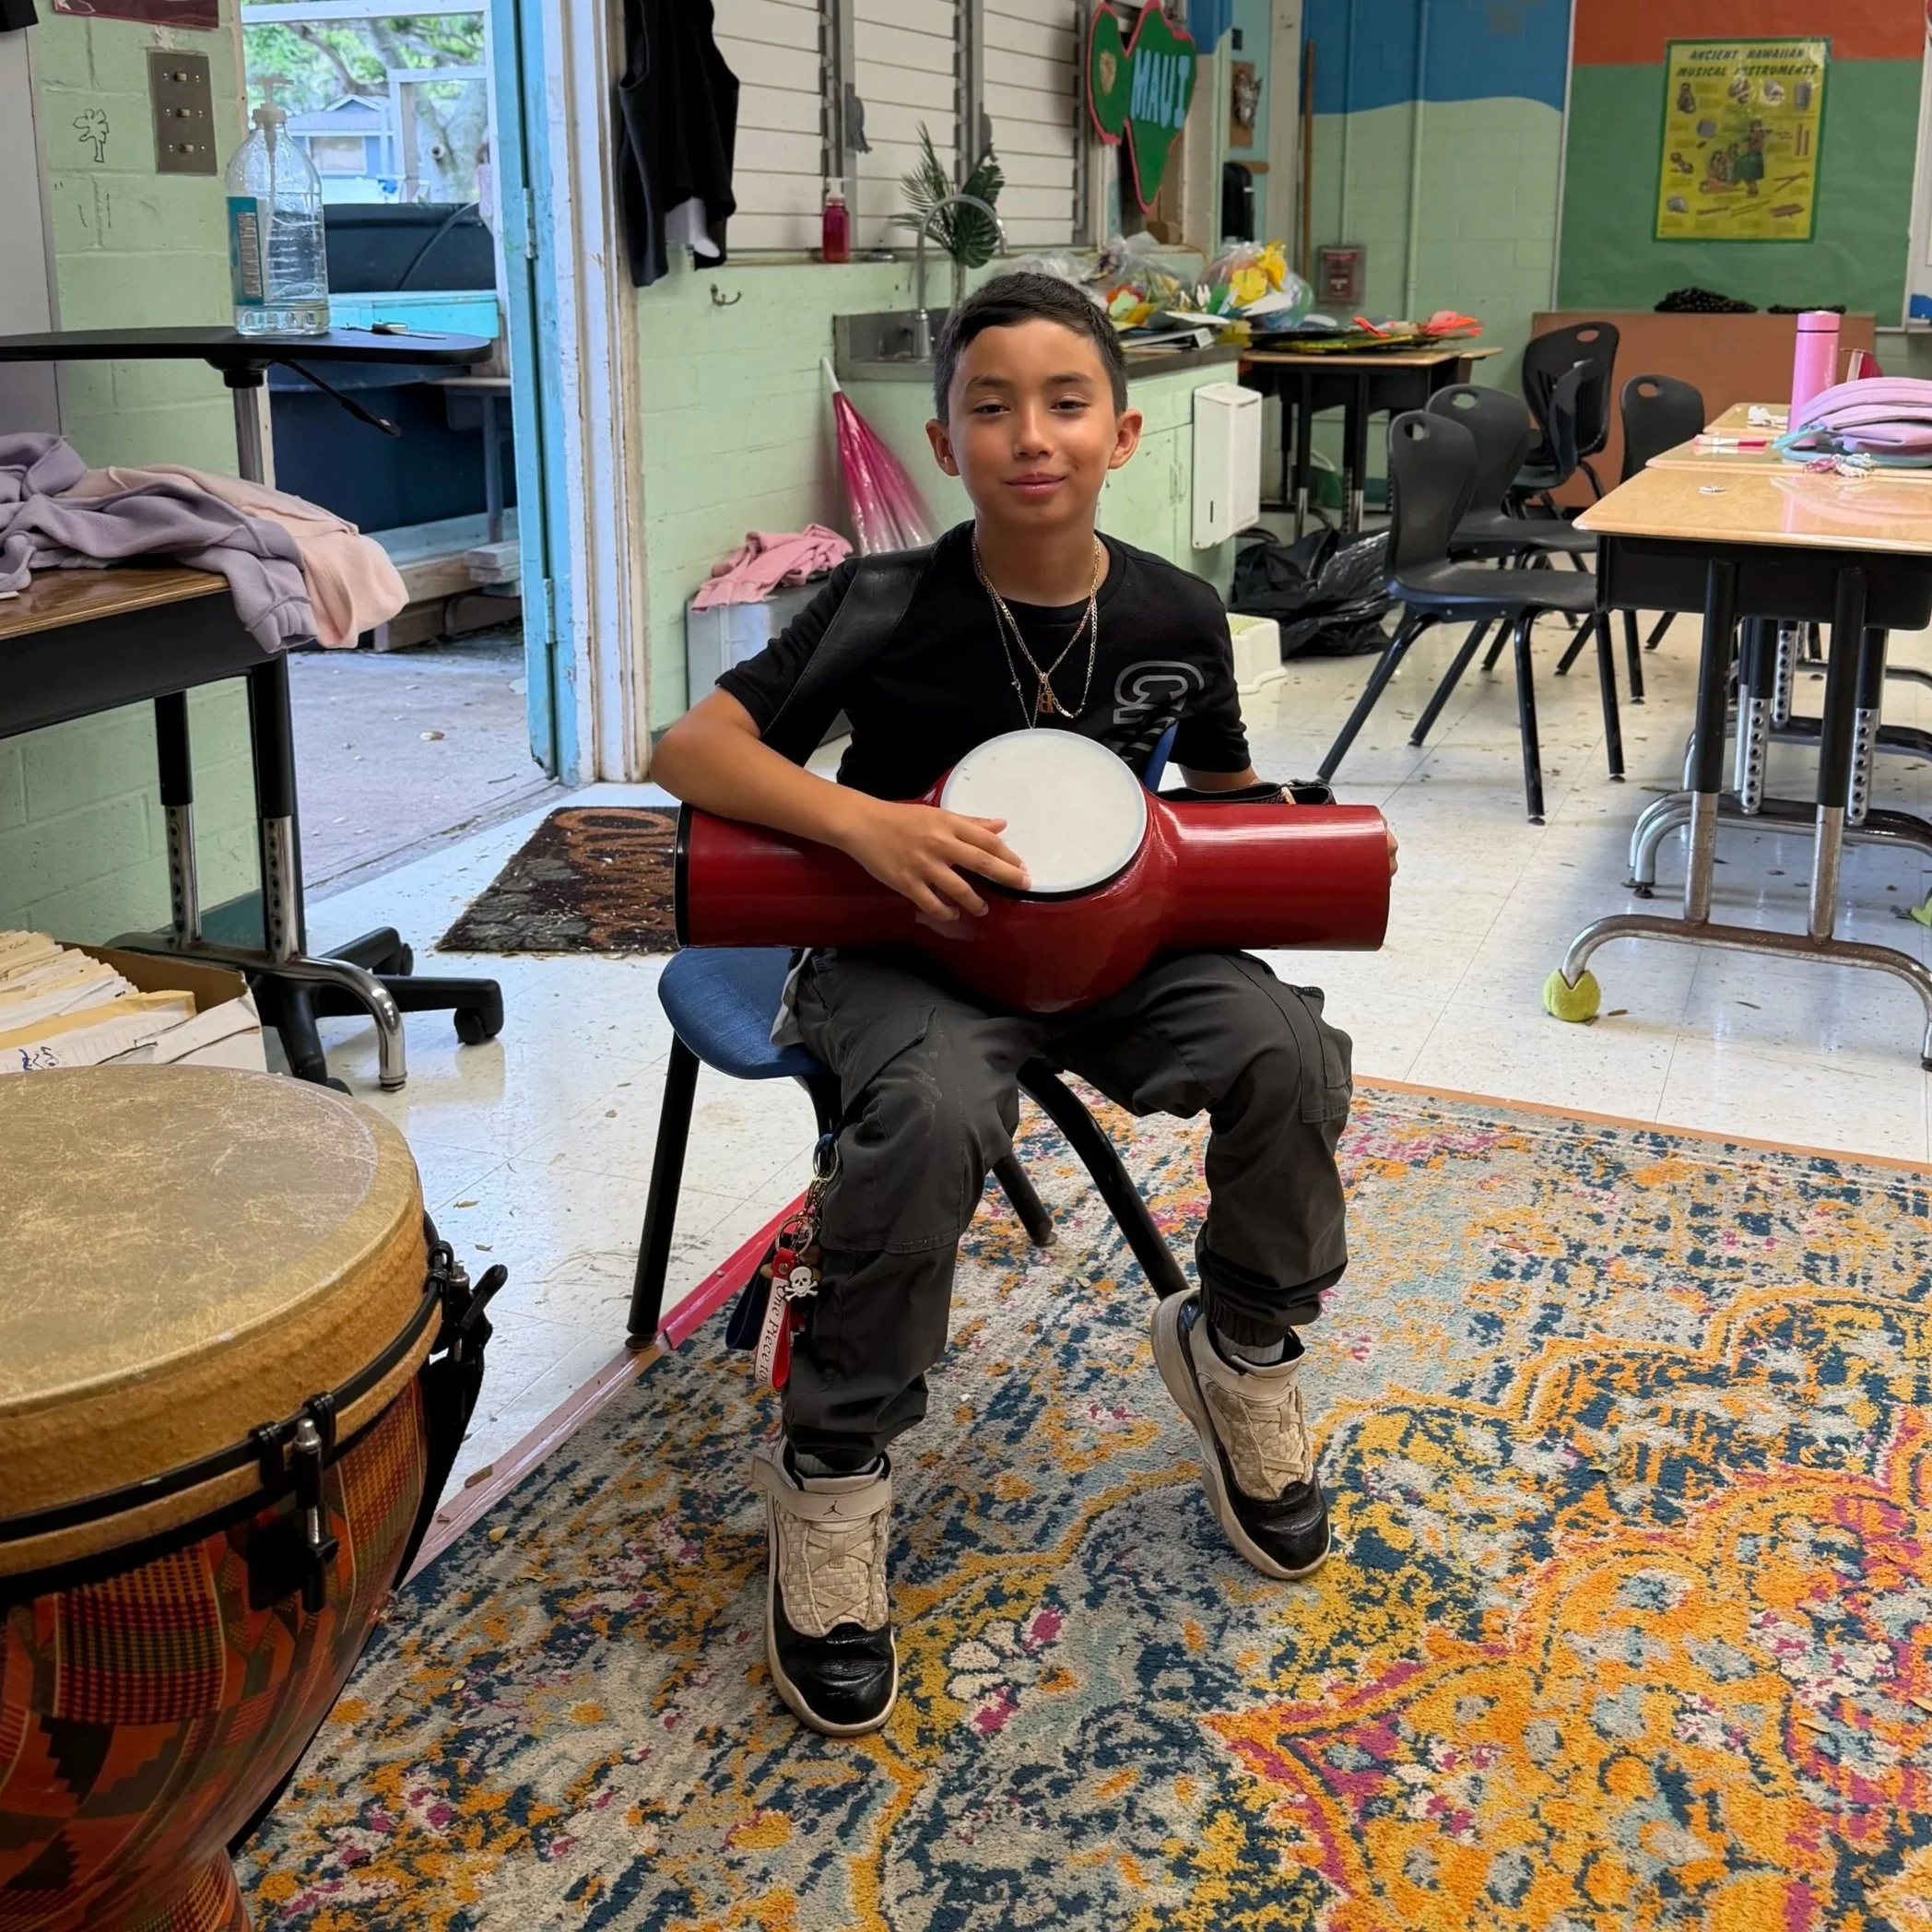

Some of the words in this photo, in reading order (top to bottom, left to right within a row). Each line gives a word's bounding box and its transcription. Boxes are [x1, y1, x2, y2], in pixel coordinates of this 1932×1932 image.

[1689, 49, 1738, 61] ANCIENT
[1746, 48, 1805, 60] HAWAIIAN
[1676, 66, 1728, 77] MUSICAL
[1733, 65, 1818, 77] INSTRUMENTS
[1130, 47, 1191, 129] MAUI
[772, 1286, 786, 1318] One
[762, 1319, 779, 1361] Piece
